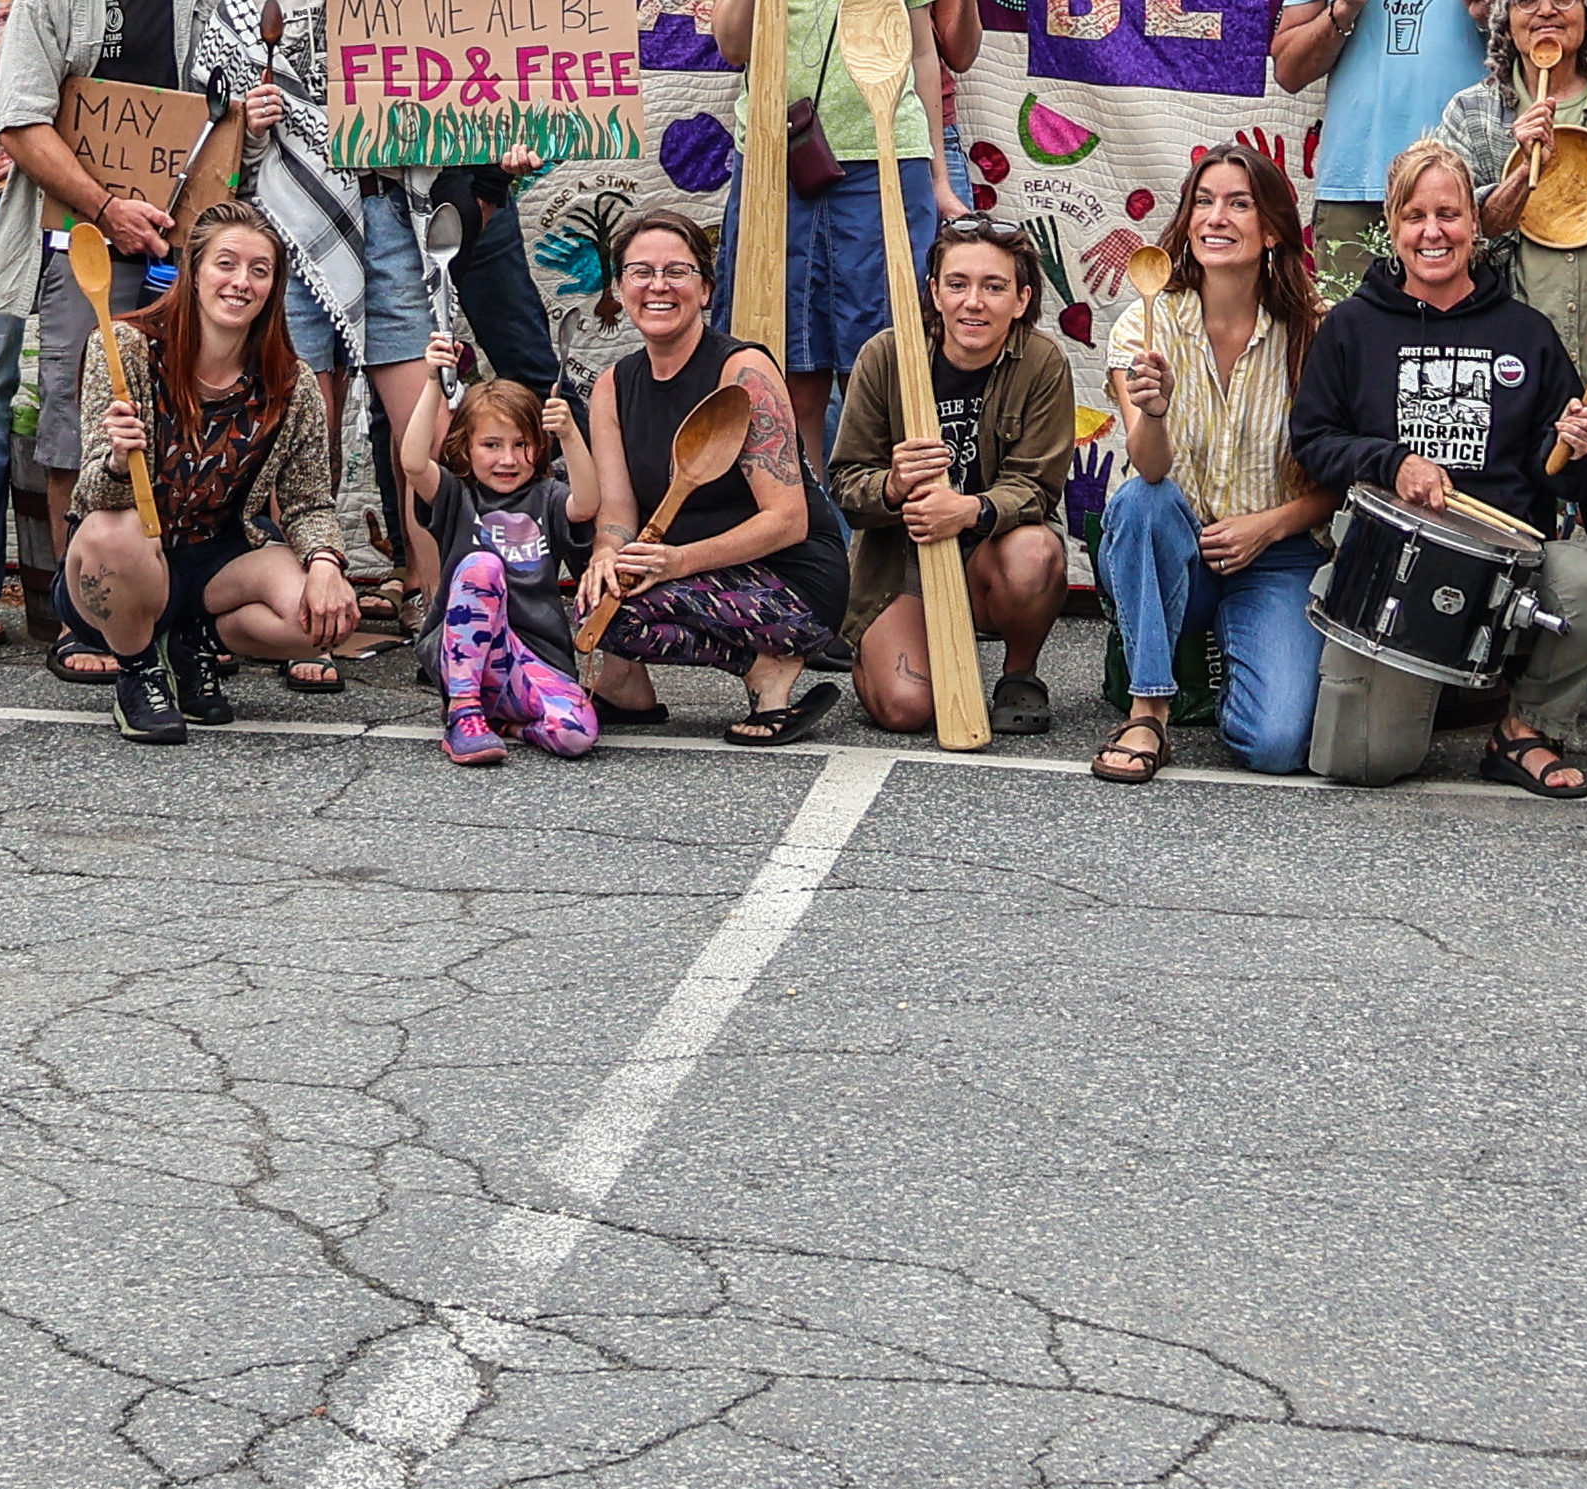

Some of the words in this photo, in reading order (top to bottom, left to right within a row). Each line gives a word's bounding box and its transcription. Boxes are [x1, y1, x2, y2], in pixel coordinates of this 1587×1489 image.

[340, 43, 454, 106] FED
[459, 45, 503, 107] &
[516, 45, 640, 103] FREE
[74, 92, 163, 139] MAY
[74, 135, 134, 171] ALL
[150, 146, 188, 179] BE
[578, 180, 588, 192] A
[1024, 179, 1072, 194] REACH
[1027, 195, 1054, 210] THE
[1060, 200, 1095, 228] BEET
[1398, 347, 1441, 357] JUSTCIA
[1445, 347, 1493, 360] MGRANTE
[938, 399, 965, 417] HE
[1400, 424, 1487, 442] MIGRANT
